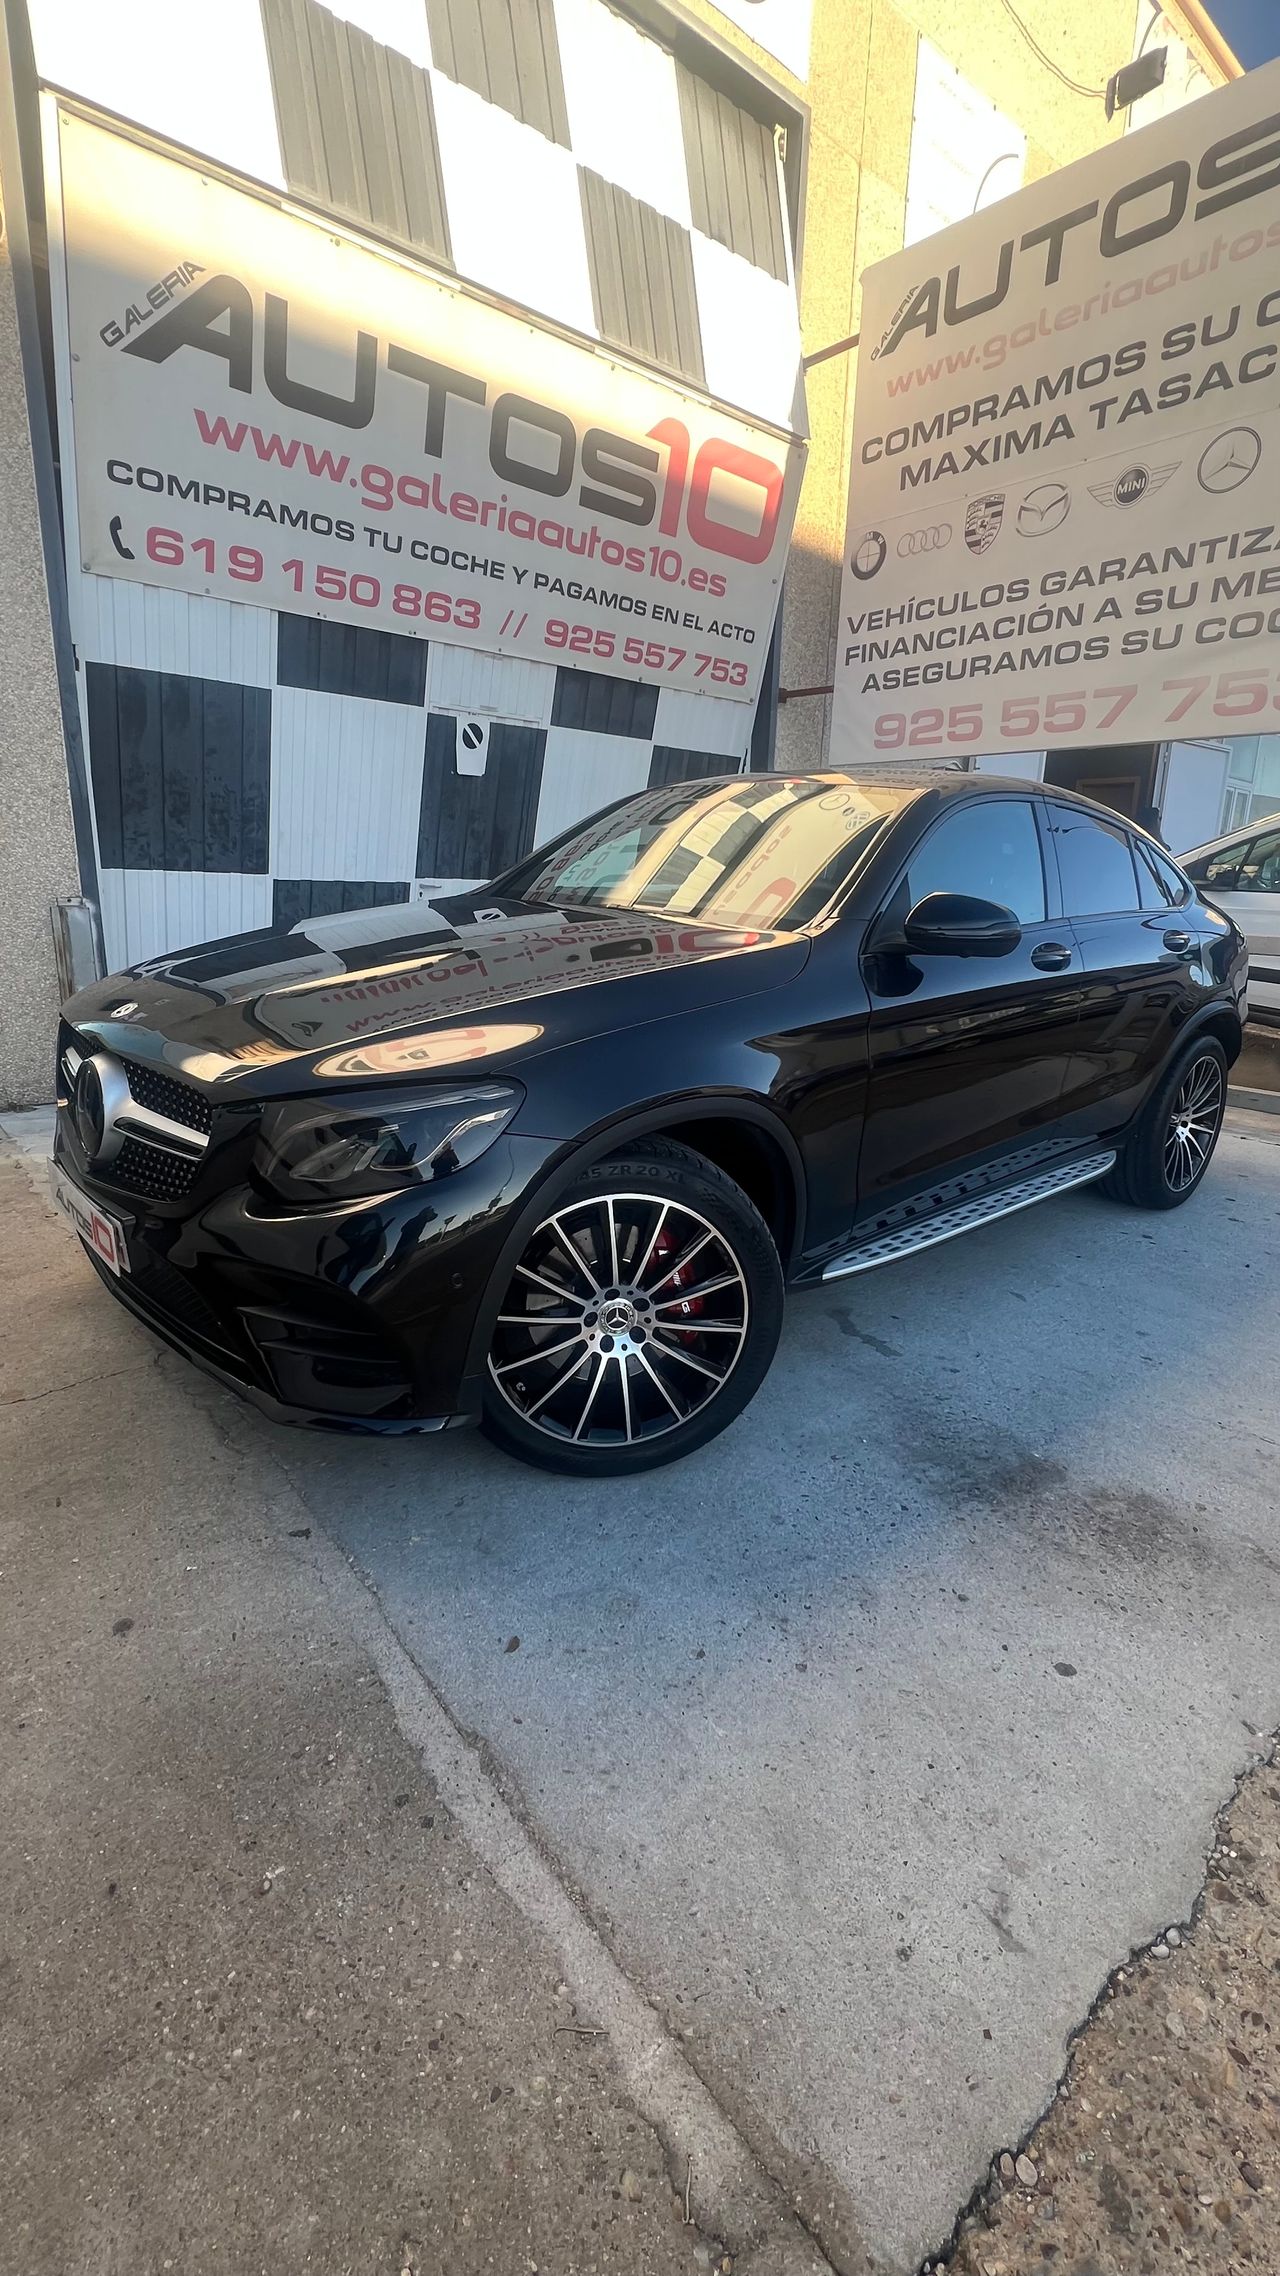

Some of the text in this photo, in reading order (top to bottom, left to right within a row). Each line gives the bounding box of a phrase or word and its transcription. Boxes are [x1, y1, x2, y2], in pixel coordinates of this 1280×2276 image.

[100, 261, 206, 347] GALERIA
[121, 274, 784, 565] AUTOS10
[861, 341, 1147, 465] COMPRAMOS
[1160, 304, 1240, 361] SU
[900, 344, 1278, 491] MAXIMA TASAC
[193, 408, 727, 598] www.galeriaautos10.es
[1117, 477, 1146, 495] MINI
[106, 459, 756, 644] COMPRAMOS TU COCHE Y PAGAMOS EN EL ACTO
[145, 526, 264, 583] 619
[281, 559, 381, 608] 150
[392, 582, 481, 630] 863
[544, 619, 615, 659] 925
[623, 638, 686, 672] 557
[693, 654, 748, 687] 753
[847, 526, 1280, 635] VEHÍCULOS GARANTIZ
[844, 602, 1085, 667] FINANCIACIÓN
[1093, 597, 1122, 624] A
[1135, 581, 1199, 616] SU
[861, 634, 1109, 694] ASEGURAMOS
[1121, 623, 1183, 655] SU
[873, 667, 1280, 750] 925 557 75
